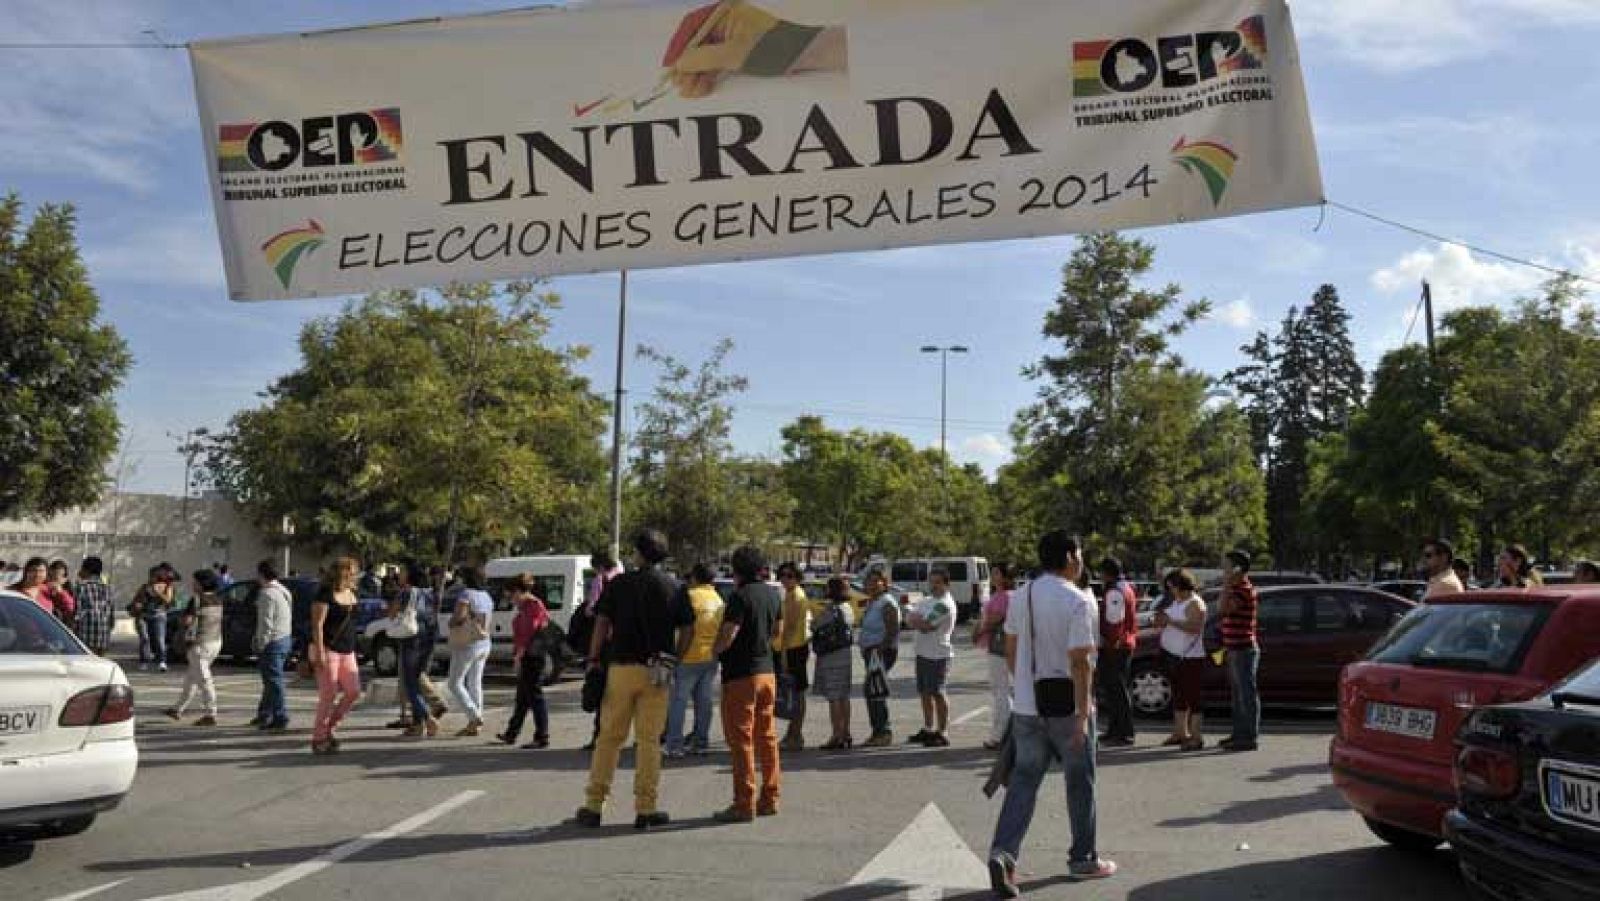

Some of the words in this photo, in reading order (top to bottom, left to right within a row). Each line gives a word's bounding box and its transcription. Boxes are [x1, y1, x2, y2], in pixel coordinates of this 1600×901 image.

[1101, 31, 1242, 93] OEP
[1075, 110, 1138, 127] TRIBUNAL
[1142, 100, 1203, 121] SUPREMO
[1208, 88, 1273, 106] ELECTORAL
[1122, 93, 1180, 107] ELECTORAL
[247, 112, 380, 172] OEP
[436, 87, 1042, 206] ENTRADA
[282, 183, 338, 197] SUPREMO
[341, 178, 407, 194] ELECTORAL
[339, 210, 651, 269] ELECCIONES
[674, 181, 997, 244] GENERALES
[1018, 164, 1159, 214] 2014
[1562, 780, 1593, 812] MU
